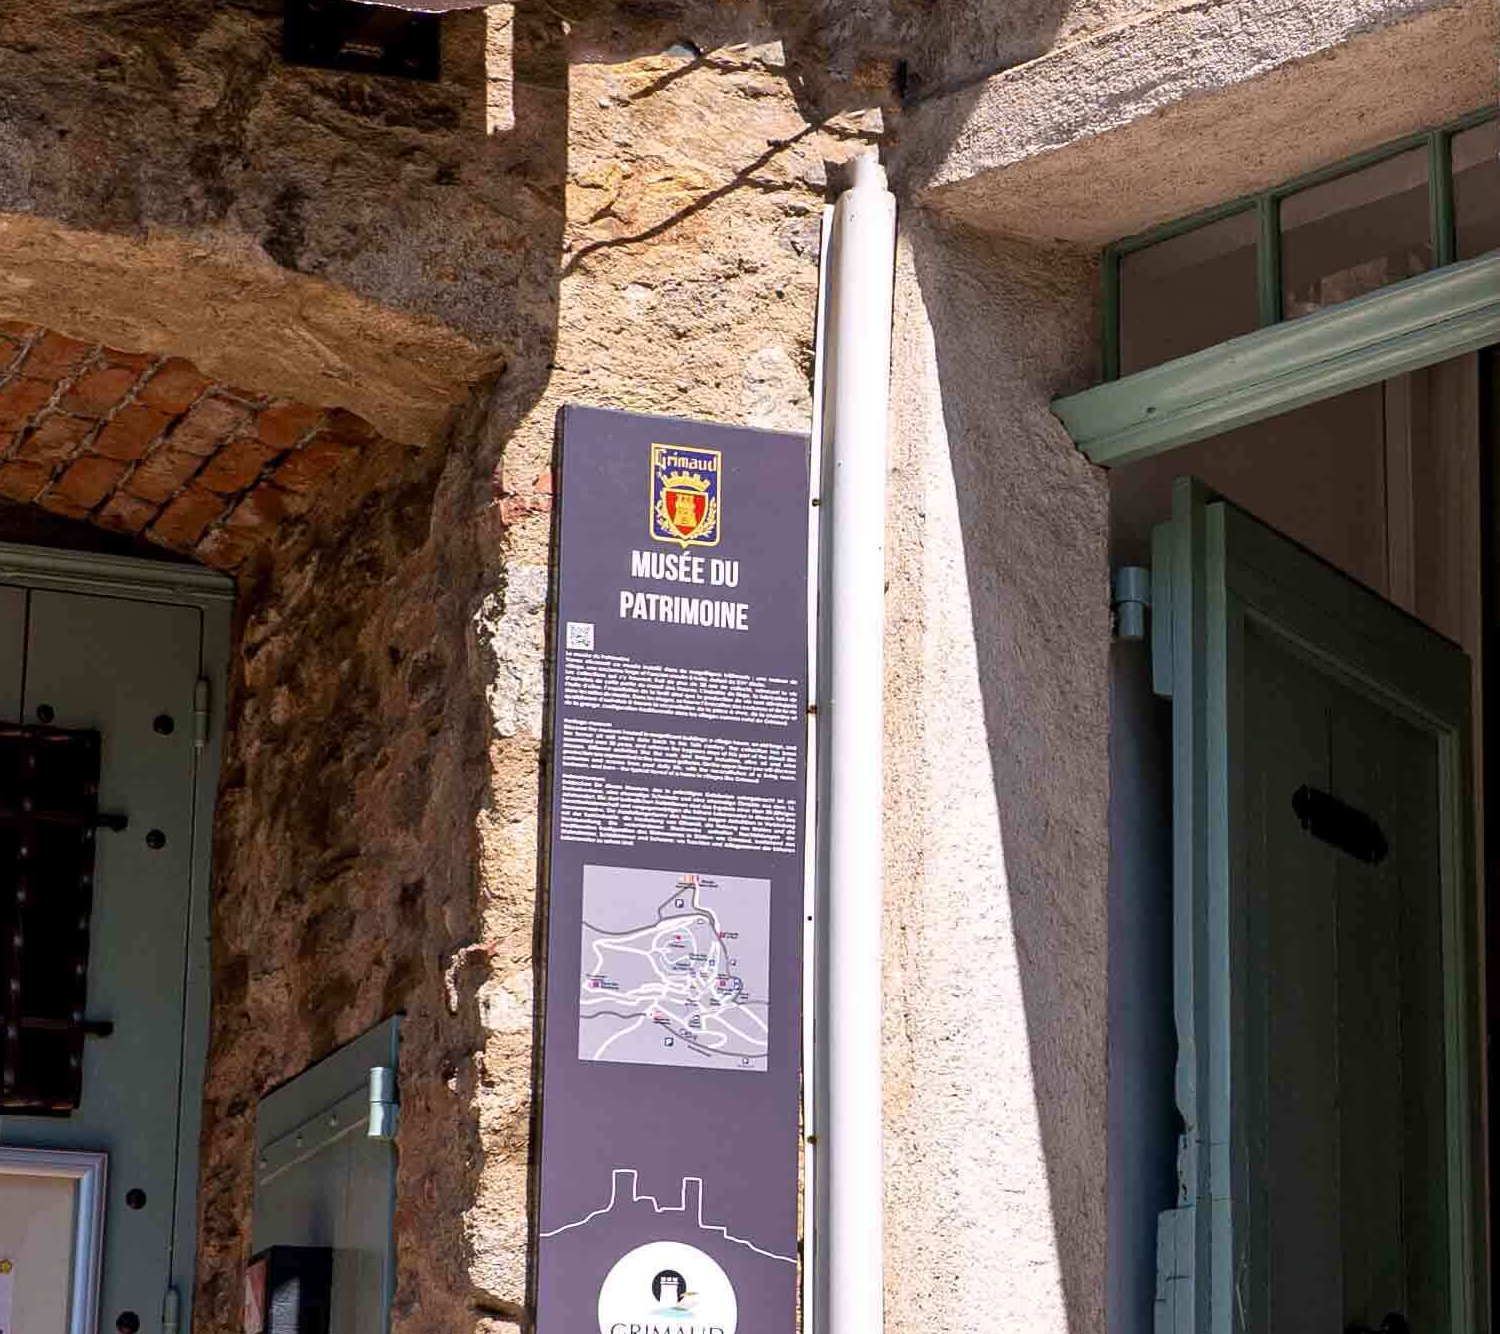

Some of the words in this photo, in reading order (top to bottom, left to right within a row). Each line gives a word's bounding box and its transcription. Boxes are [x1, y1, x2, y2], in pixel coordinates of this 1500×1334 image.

[655, 449, 717, 472] Grimaud
[631, 549, 705, 585] MUSÉE
[710, 558, 739, 589] DU
[619, 590, 749, 631] PATRIMOINE
